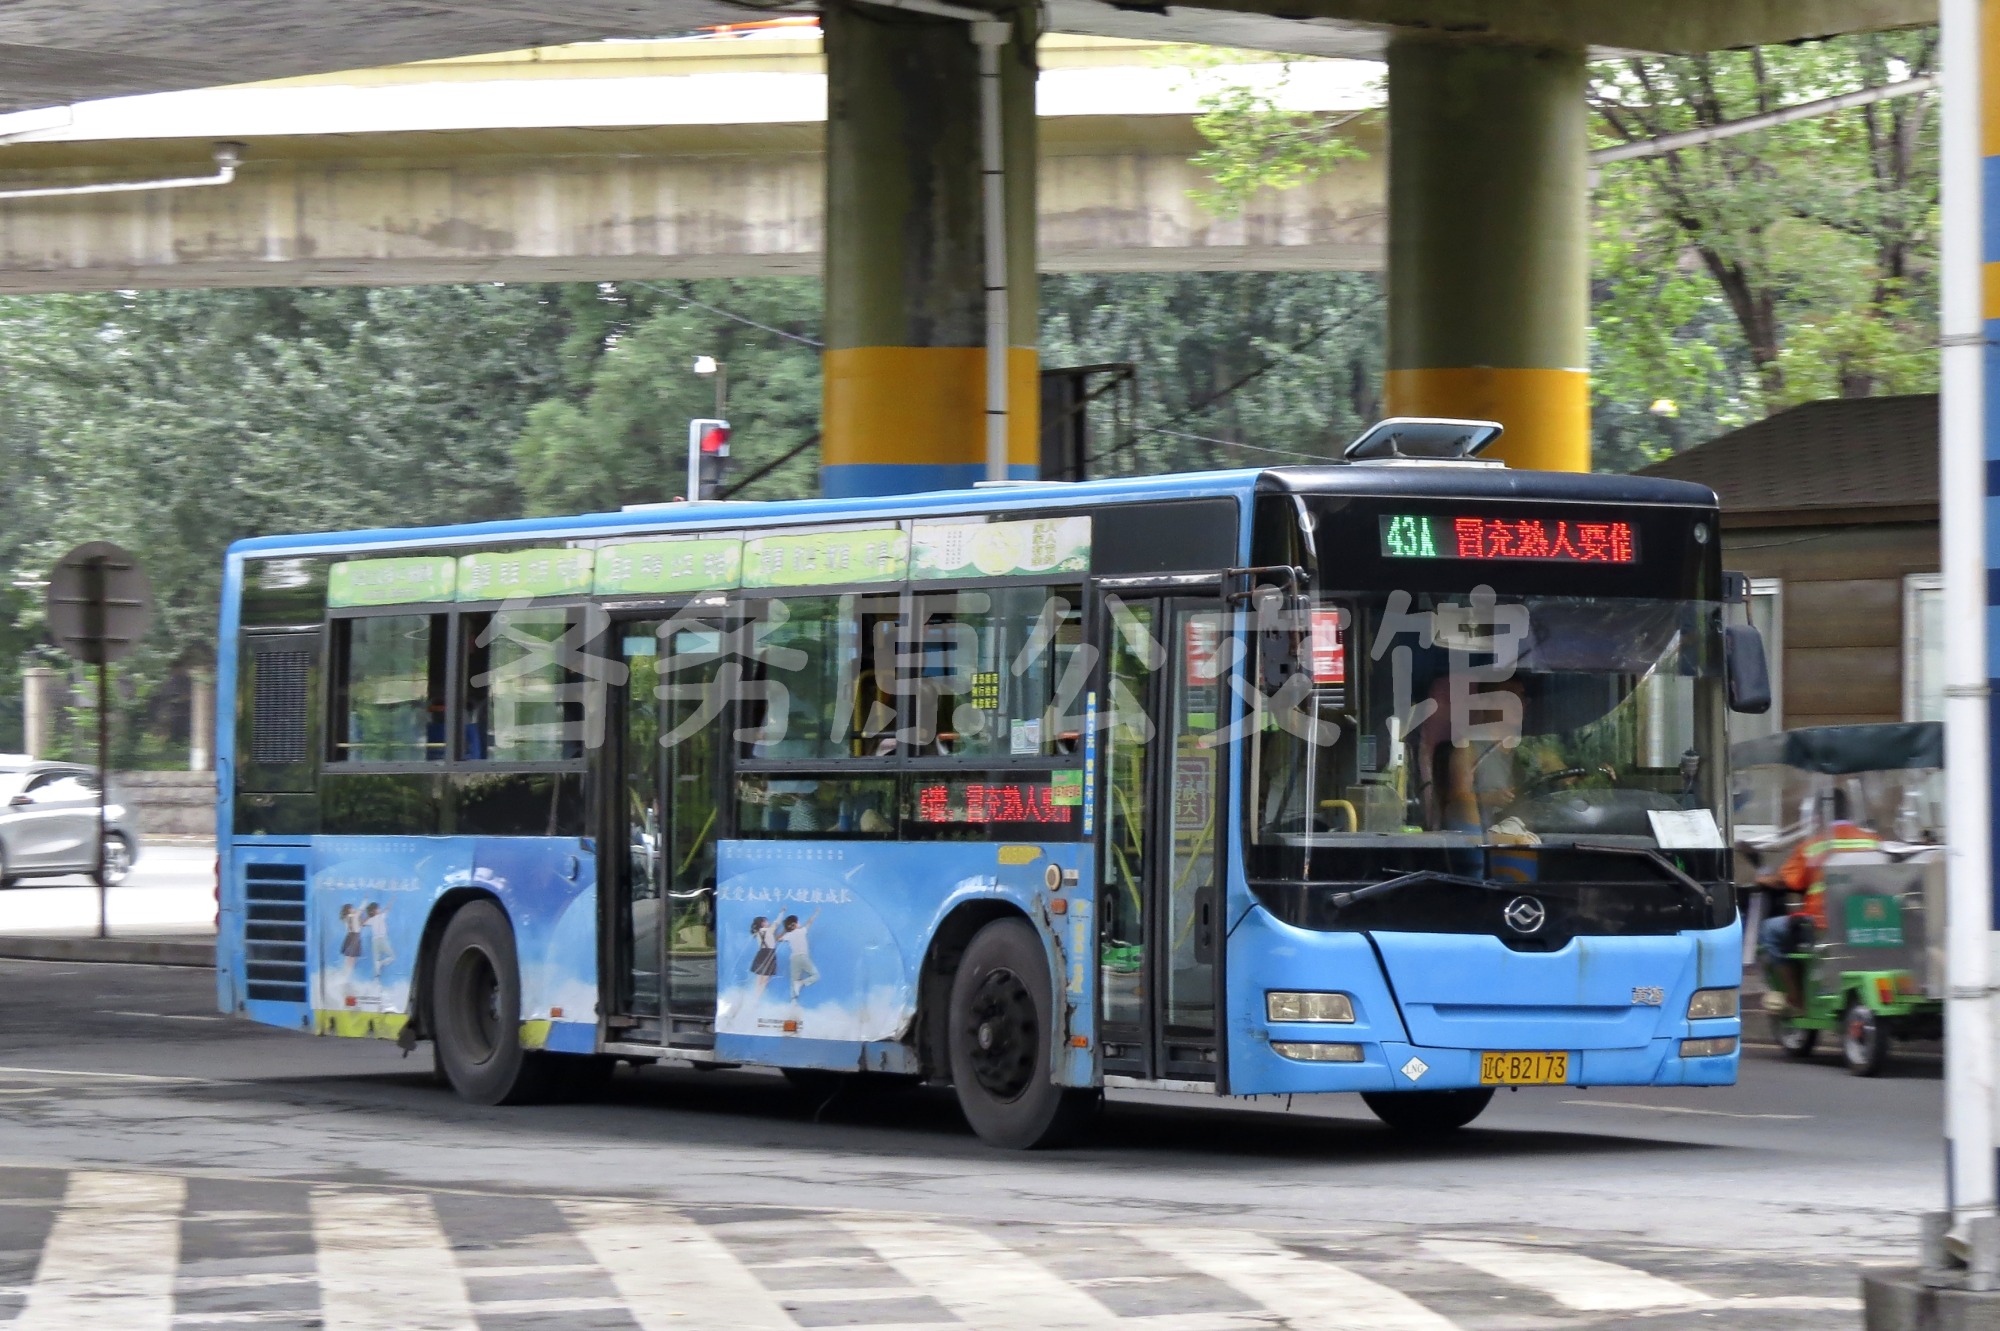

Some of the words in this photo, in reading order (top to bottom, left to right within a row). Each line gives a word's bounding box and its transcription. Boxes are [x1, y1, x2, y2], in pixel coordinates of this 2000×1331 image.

[1387, 516, 1436, 556] 43A
[1631, 986, 1664, 1005] 黄海
[1406, 1063, 1424, 1075] LNG
